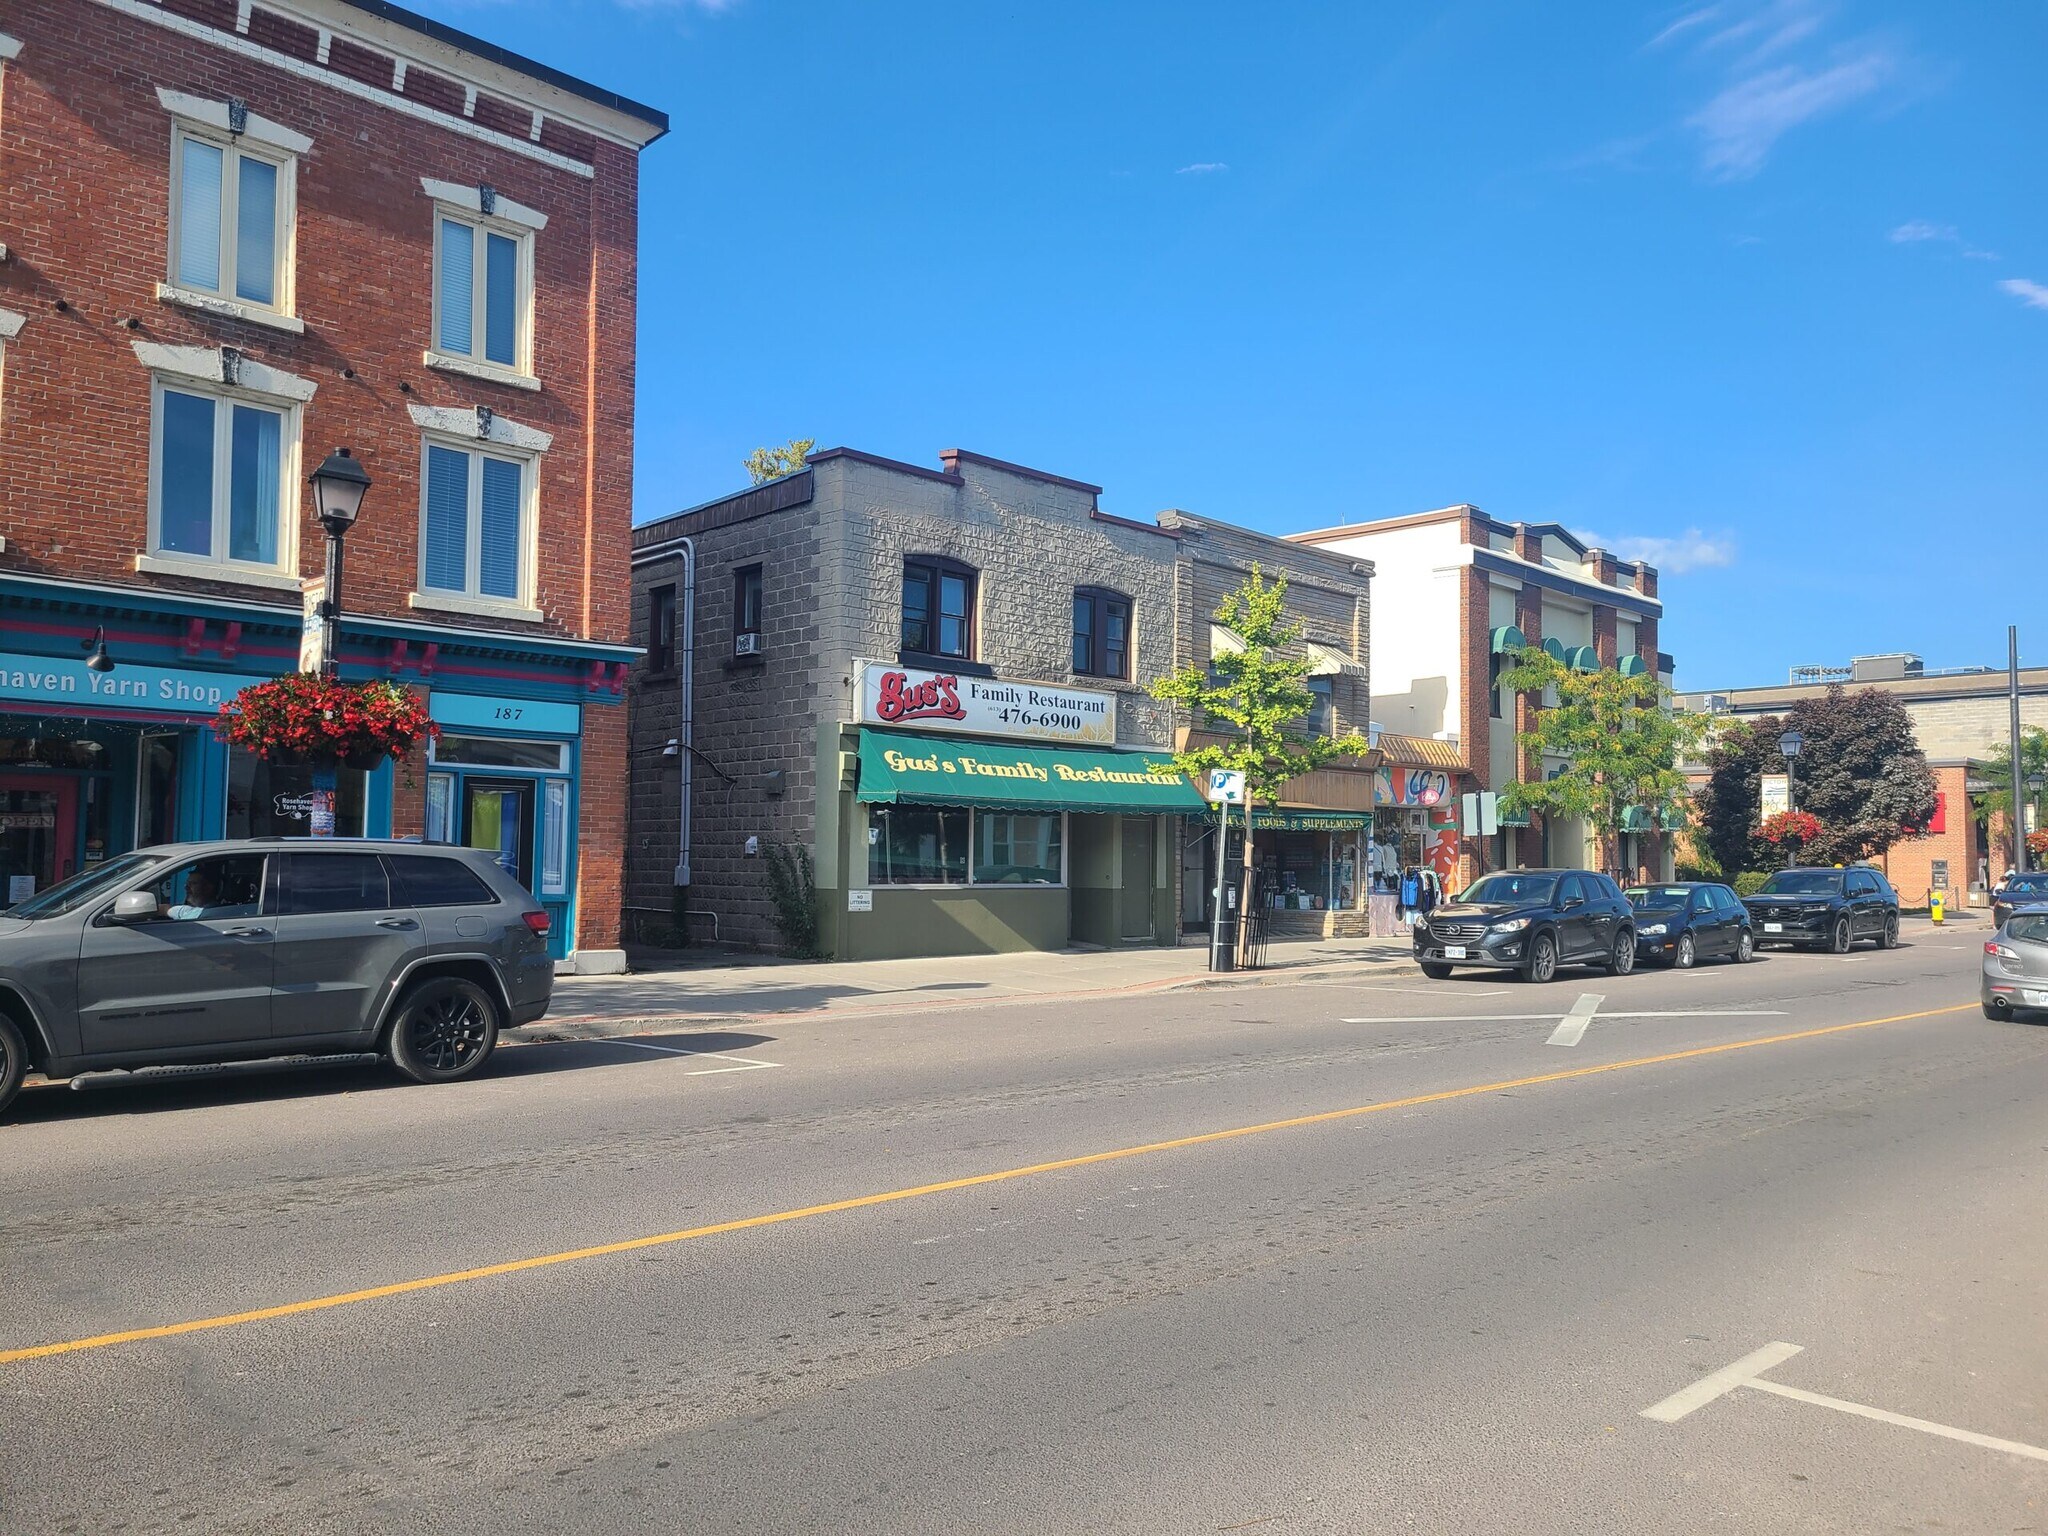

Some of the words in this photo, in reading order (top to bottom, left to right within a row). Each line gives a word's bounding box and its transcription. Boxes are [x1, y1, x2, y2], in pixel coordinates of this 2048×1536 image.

[88, 672, 148, 697] Yarn
[159, 677, 222, 706] Shop
[970, 682, 1024, 707] Family
[1028, 691, 1106, 714] Restaurant
[494, 707, 523, 720] 187
[998, 708, 1082, 731] 476-6900
[884, 749, 957, 774] Gus's
[957, 756, 1049, 782] Family
[1053, 763, 1184, 786] Restaurant
[0, 816, 53, 826] OPEN
[1257, 816, 1286, 827] FOODS
[1290, 817, 1298, 828] &
[1302, 817, 1364, 828] SUPPLEMENTS
